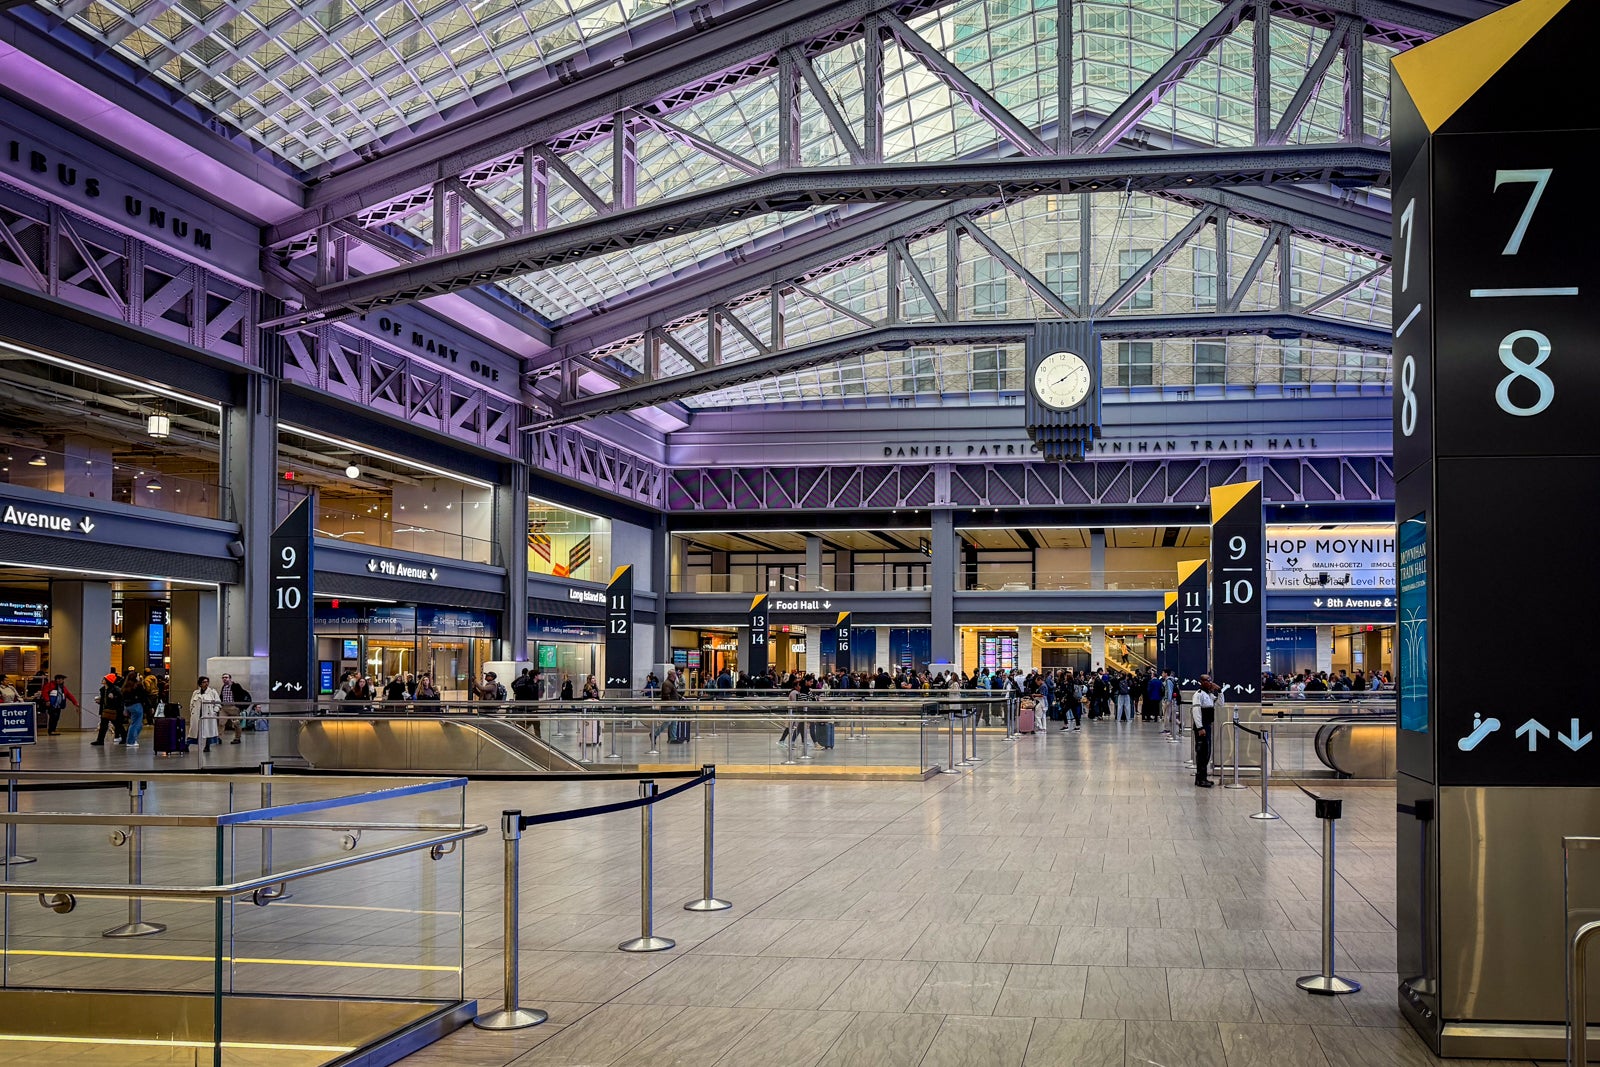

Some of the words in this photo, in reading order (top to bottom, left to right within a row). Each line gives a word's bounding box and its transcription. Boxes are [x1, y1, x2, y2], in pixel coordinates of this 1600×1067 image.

[1493, 168, 1553, 255] 7
[125, 195, 212, 250] UNUM
[1400, 198, 1415, 292] 7
[379, 317, 402, 336] OF
[412, 331, 458, 362] MANY
[470, 360, 499, 381] ONE
[1495, 330, 1555, 416] 8
[1401, 355, 1417, 436] 8
[884, 445, 953, 457] DANIEL
[967, 444, 1040, 455] PATRIC
[1099, 441, 1176, 453] YNIHAN
[1191, 439, 1253, 450] TRAIN
[1268, 438, 1318, 449] HALL
[4, 506, 72, 531] Avenue
[1229, 536, 1246, 560] 9
[1266, 539, 1307, 554] HOP
[1316, 539, 1395, 553] MOYNIH
[1400, 542, 1426, 566] MOYNIHAN
[281, 547, 296, 569] 9
[380, 560, 395, 575] 9th
[396, 563, 427, 579] Avenue
[1414, 559, 1426, 577] HALL
[1278, 577, 1299, 586] Visit
[1351, 576, 1376, 586] Level
[276, 586, 301, 609] 10
[570, 588, 583, 602] Long
[583, 591, 599, 602] Island
[1185, 592, 1200, 606] 11
[1223, 579, 1253, 604] 10
[612, 595, 625, 609] 11
[776, 600, 798, 609] Food
[800, 600, 819, 609] Hall
[1327, 598, 1343, 607] 8th
[1345, 598, 1382, 608] Avenue
[1383, 597, 1392, 607] &
[341, 616, 371, 624] Customer
[373, 616, 397, 624] Service
[610, 619, 626, 634] 12
[753, 616, 764, 627] 13
[1184, 617, 1202, 633] 12
[752, 633, 764, 645] 14
[840, 628, 848, 637] 15
[840, 642, 849, 651] 16
[1, 709, 28, 717] Enter
[3, 718, 26, 726] here
